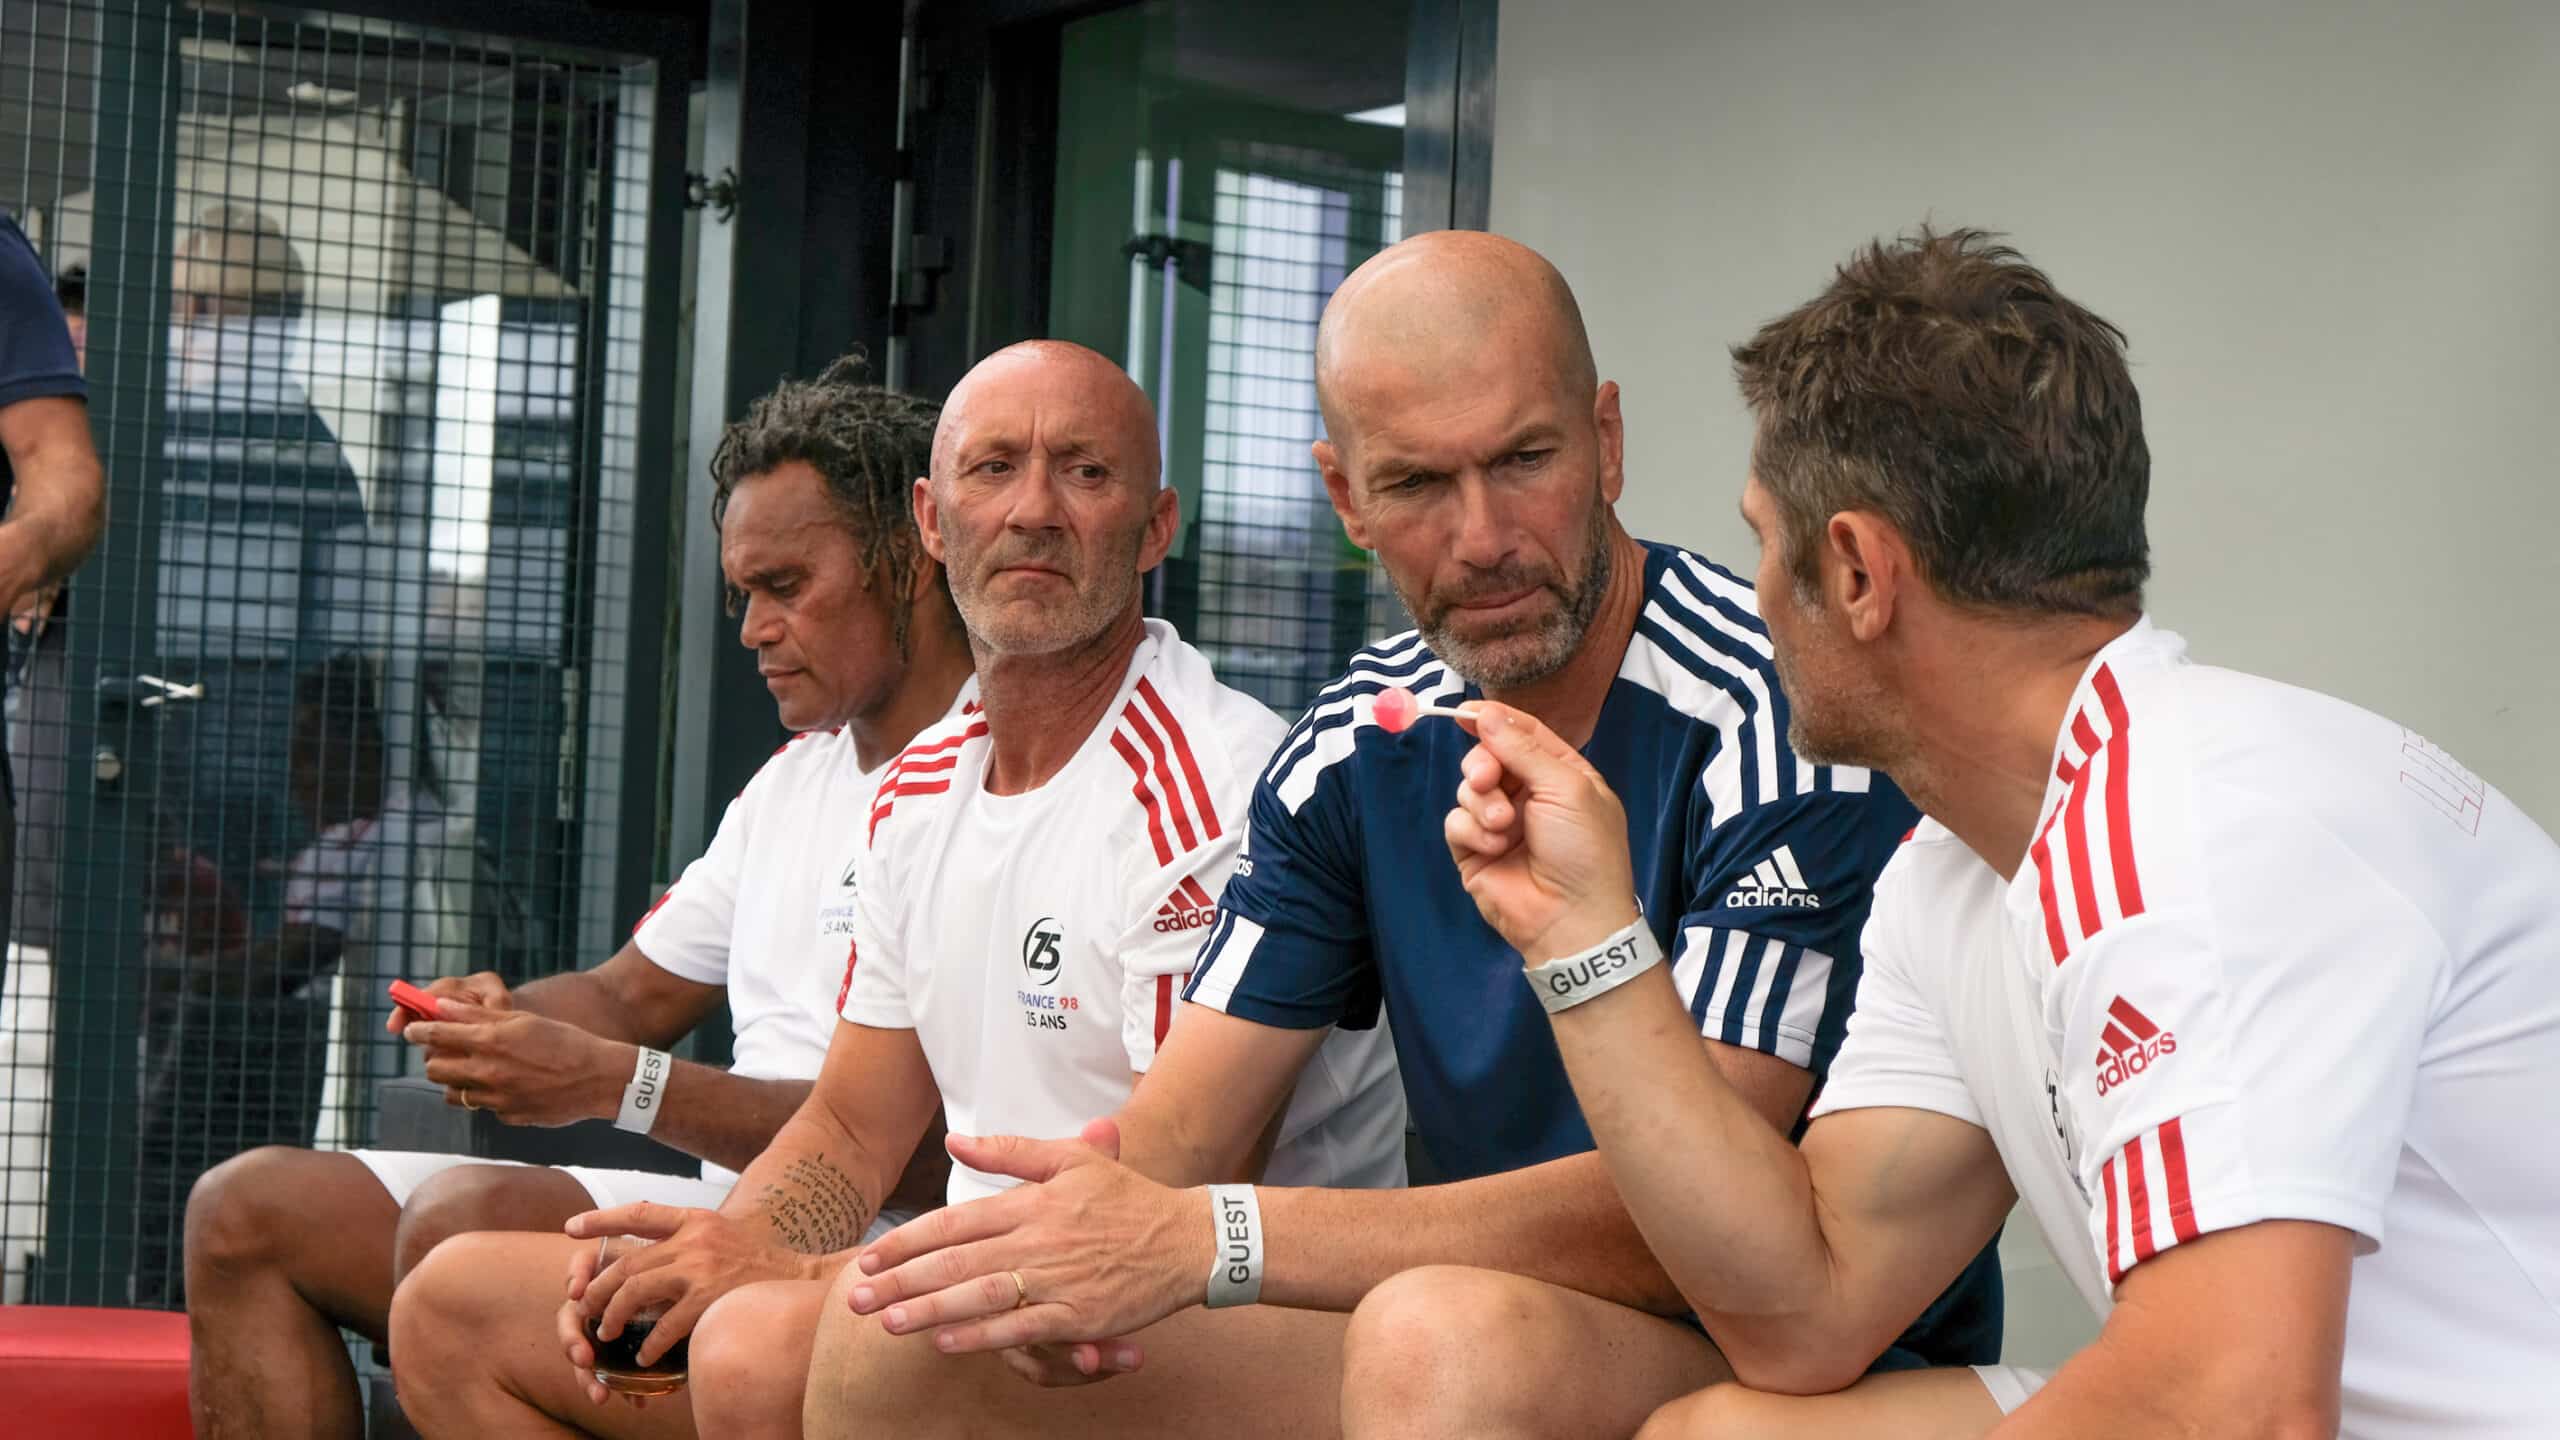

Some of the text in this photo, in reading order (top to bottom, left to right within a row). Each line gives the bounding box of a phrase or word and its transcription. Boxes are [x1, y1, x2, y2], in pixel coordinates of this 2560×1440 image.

[1726, 886, 1820, 909] adidas
[1153, 907, 1216, 933] adida
[1550, 936, 1638, 995] GUEST
[1039, 1013, 1067, 1030] ANS
[1059, 997, 1078, 1011] 98
[635, 1051, 662, 1110] GUEST
[2096, 1031, 2176, 1097] adidas
[1222, 1196, 1250, 1285] GUEST
